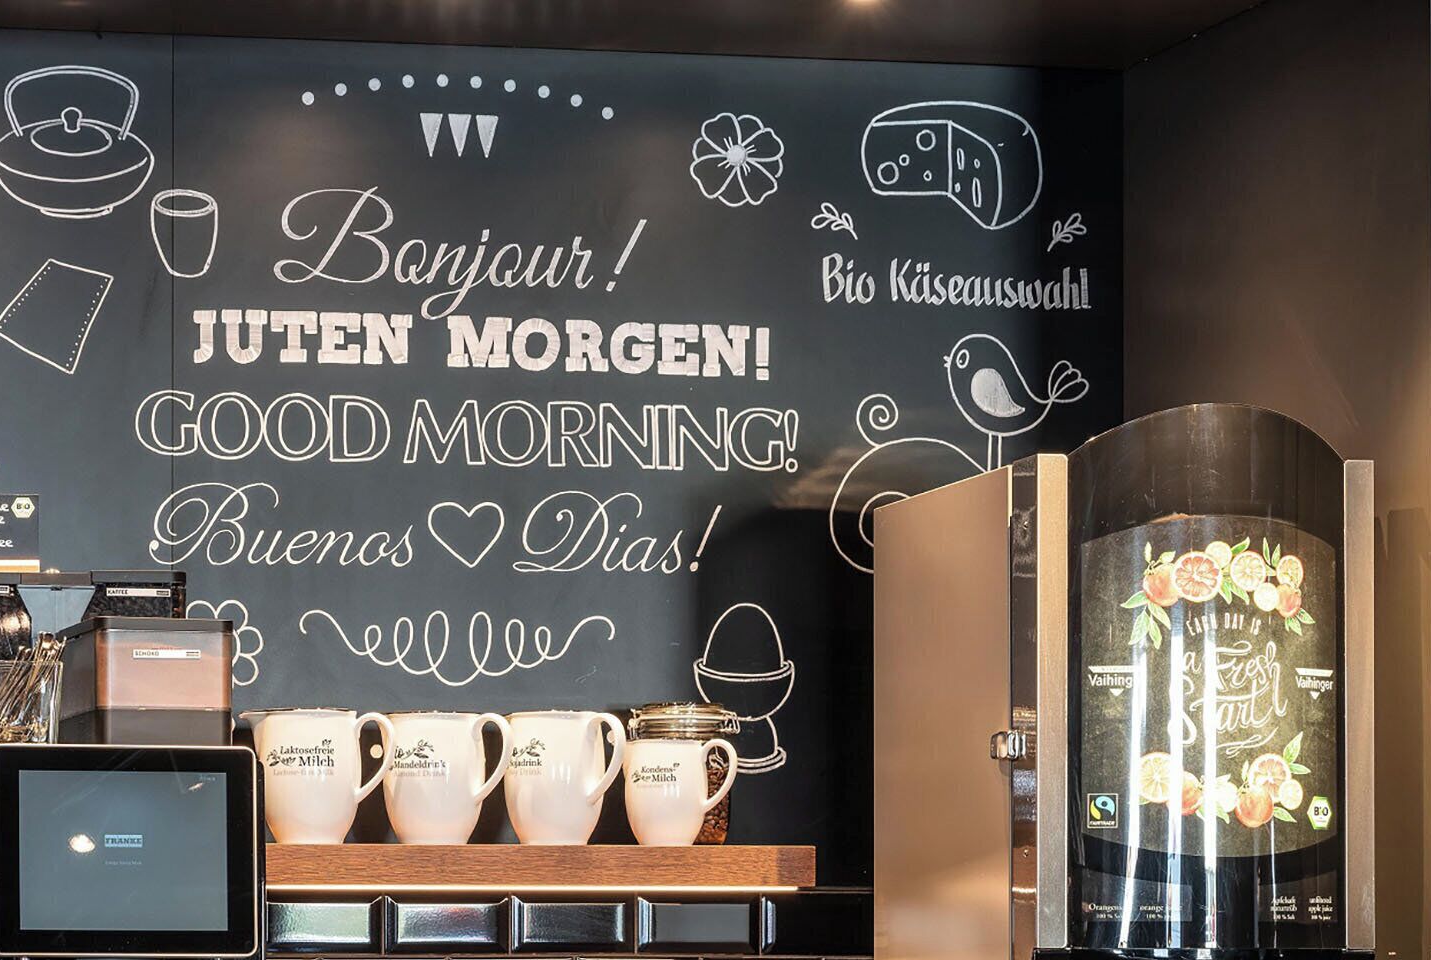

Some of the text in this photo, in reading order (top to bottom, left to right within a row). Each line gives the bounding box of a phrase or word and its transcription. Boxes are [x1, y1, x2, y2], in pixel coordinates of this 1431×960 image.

[821, 252, 1092, 310] Bio Käseauswahl
[192, 308, 770, 381] JUTEN MORGEN!
[135, 389, 799, 474] GOOD MORNING!
[148, 481, 723, 575] Buenos Dias!
[1224, 612, 1245, 630] DAY
[1251, 618, 1262, 636] IS
[1088, 674, 1134, 689] Vaihing
[1295, 675, 1333, 691] Vaihinger
[280, 745, 335, 755] Laktosefreie
[298, 755, 335, 768] Milch
[393, 760, 446, 769] Mandeldrink
[651, 774, 677, 783] Milch
[1139, 904, 1164, 913] orange
